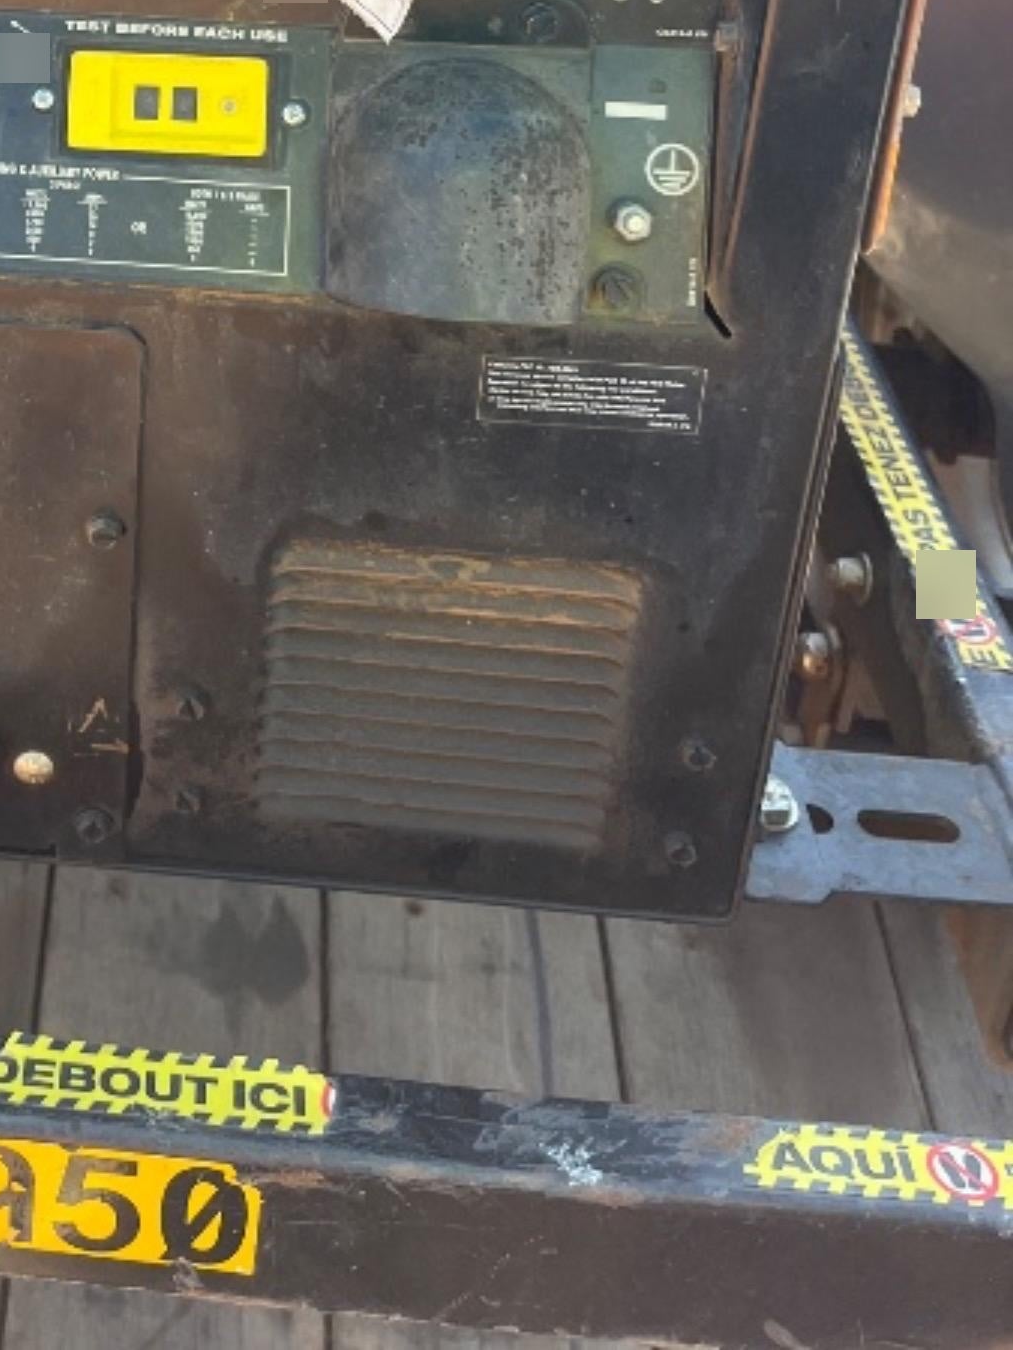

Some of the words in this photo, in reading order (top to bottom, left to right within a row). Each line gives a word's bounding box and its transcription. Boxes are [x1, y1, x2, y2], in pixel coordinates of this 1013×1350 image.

[65, 20, 111, 34] TEST
[115, 23, 189, 37] BEFORE
[193, 26, 246, 40] EACH
[250, 29, 288, 43] USE
[129, 220, 147, 235] OR
[863, 424, 919, 500] TENEZ
[232, 1079, 307, 1117] ICI
